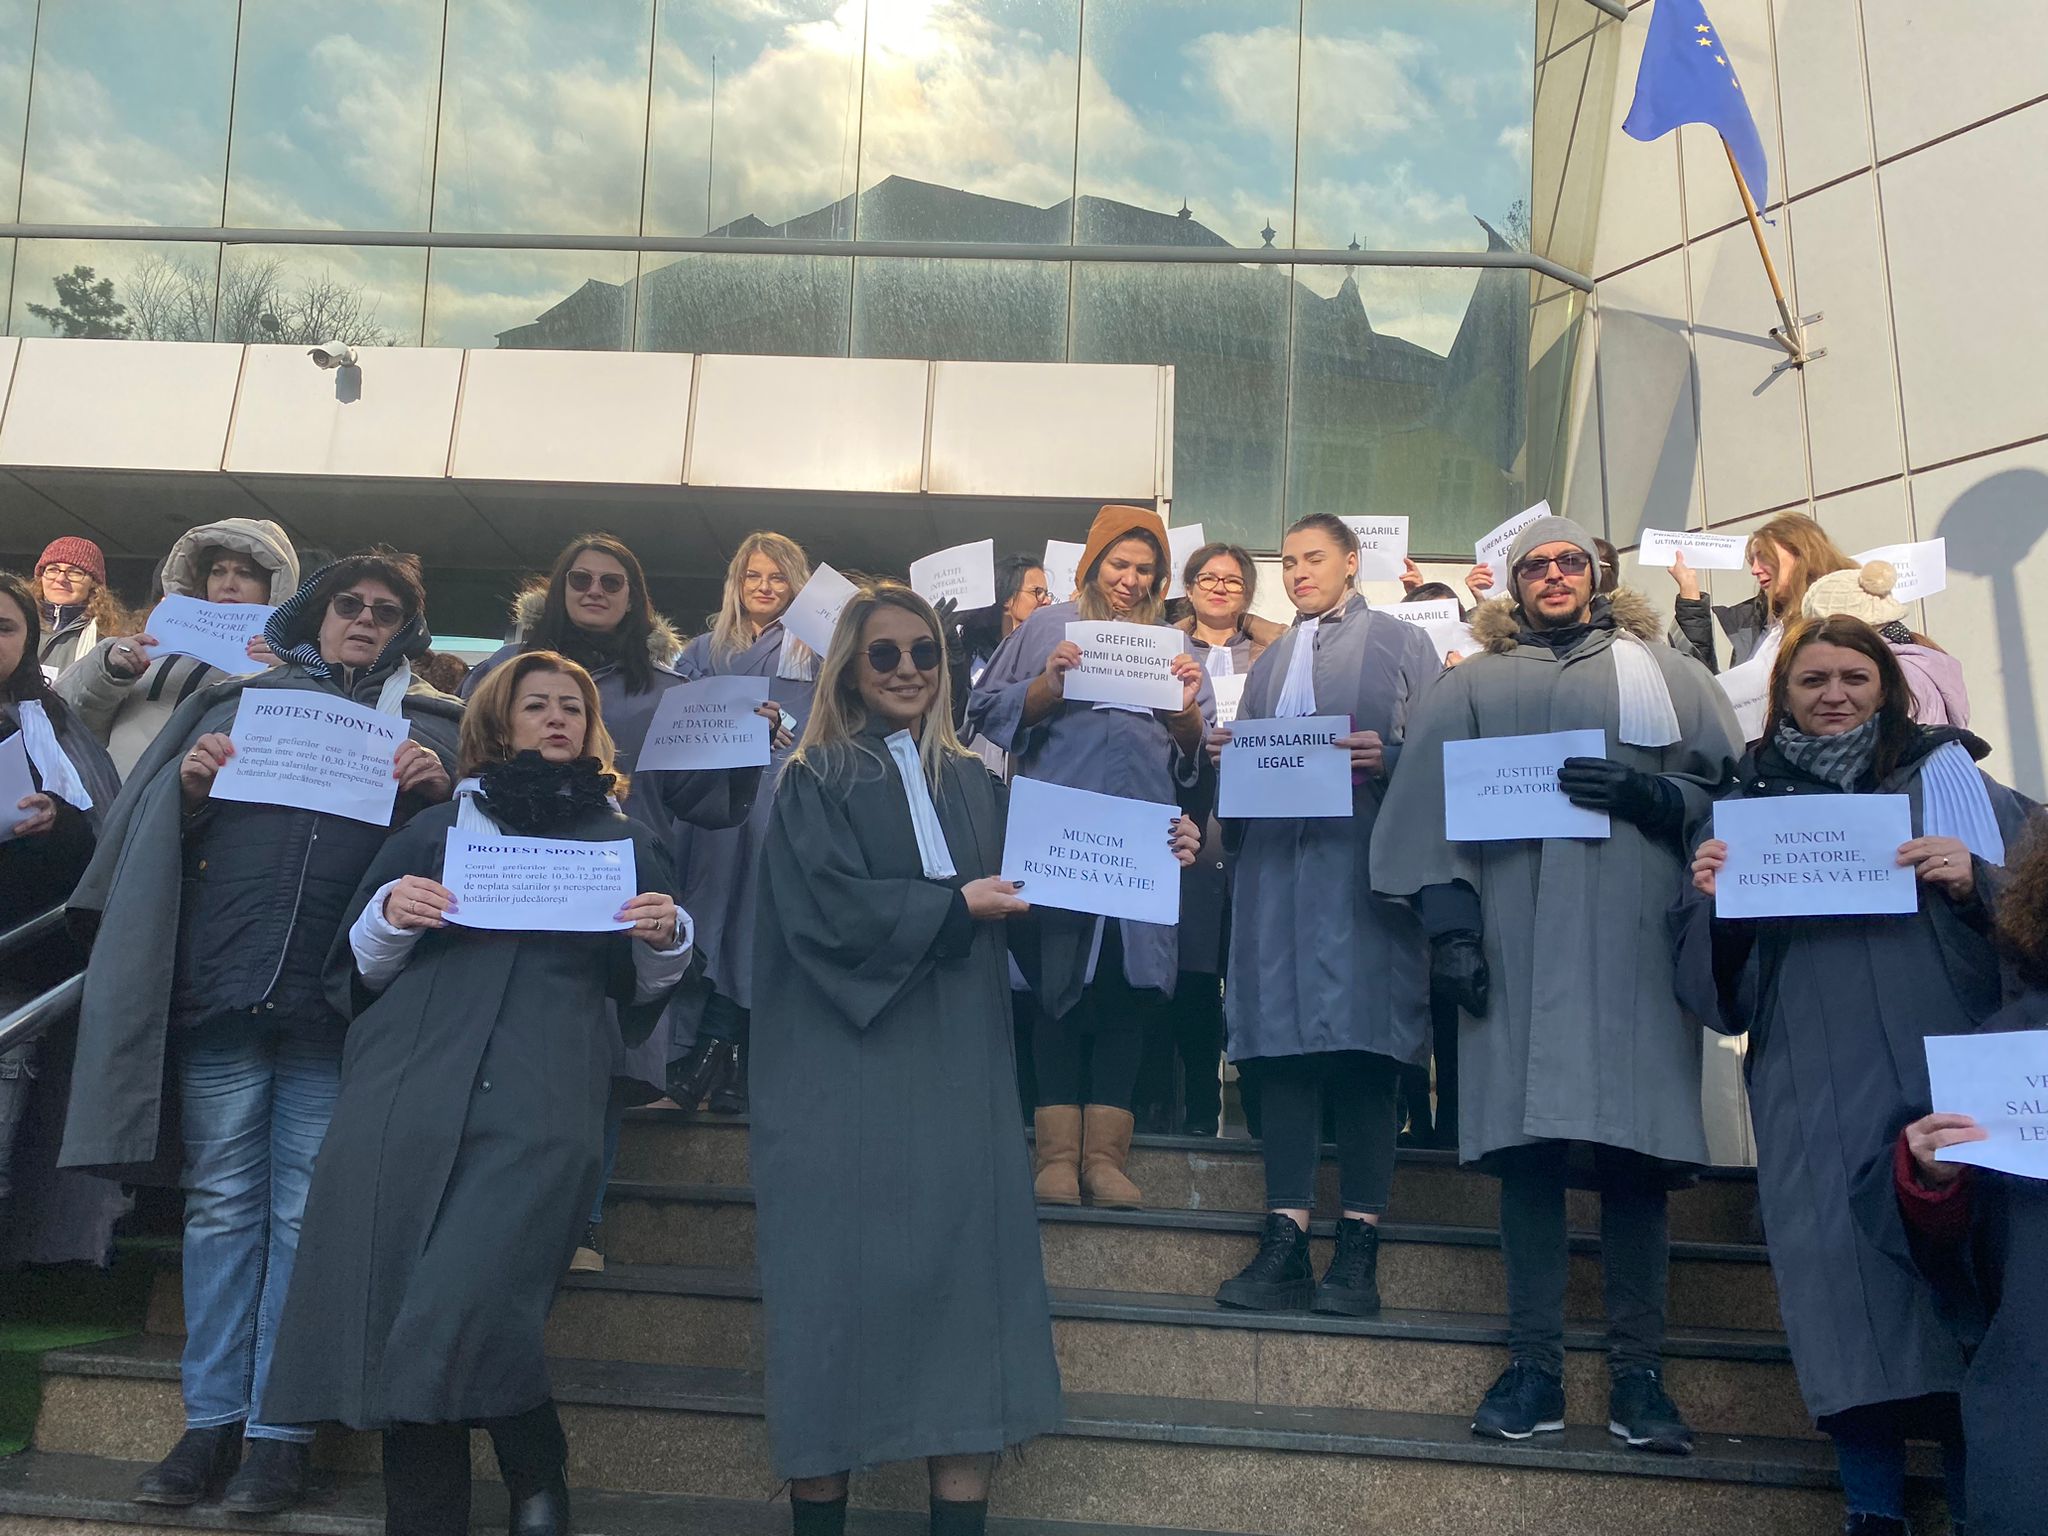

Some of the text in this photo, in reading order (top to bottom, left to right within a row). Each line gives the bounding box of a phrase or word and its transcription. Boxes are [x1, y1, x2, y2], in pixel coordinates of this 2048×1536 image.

[1482, 535, 1502, 553] VREM
[197, 609, 260, 621] MUNCIM PE
[1096, 633, 1156, 648] GREFIERII:
[1079, 649, 1109, 661] RIMII
[1112, 653, 1123, 662] LA
[1080, 665, 1169, 681] ULTIMII LA DREPTURI
[683, 703, 727, 714] MUNCIM
[255, 704, 394, 740] PROTEST SPONTAN
[673, 720, 684, 729] PE
[732, 733, 753, 743] FIE!
[1233, 733, 1336, 748] VREM SALARIILE
[242, 746, 272, 755] spontan
[296, 750, 317, 761] orele
[245, 733, 272, 743] Corpul
[278, 736, 320, 749] grefierilor
[325, 745, 342, 753] este
[361, 753, 390, 766] protest
[1258, 756, 1304, 769] LEGALE
[239, 756, 249, 765] de
[251, 757, 279, 768] neplata
[281, 759, 318, 773] salariilor
[329, 769, 384, 788] nerespectarea
[1062, 828, 1124, 848] MUNCIM
[1775, 830, 1845, 844] MUNCIM
[467, 844, 619, 857] PROTEST SPONTAN
[1049, 845, 1137, 870] PE DATORIE,
[1763, 850, 1865, 864] PE DATORIE,
[465, 863, 495, 872] Corpul
[502, 863, 546, 872] grefierilor
[592, 865, 621, 873] protest
[465, 872, 498, 880] spontan
[525, 872, 547, 880] orele
[1080, 869, 1099, 882] SĂ
[1104, 872, 1124, 886] VĂ
[1128, 876, 1155, 891] FIE!
[1802, 870, 1824, 883] SĂ
[1828, 869, 1852, 882] VĂ
[1858, 869, 1889, 882] FIE!
[463, 882, 474, 890] de
[477, 882, 509, 892] neplata
[512, 882, 550, 891] salariilor
[563, 884, 621, 893] nerespectarea
